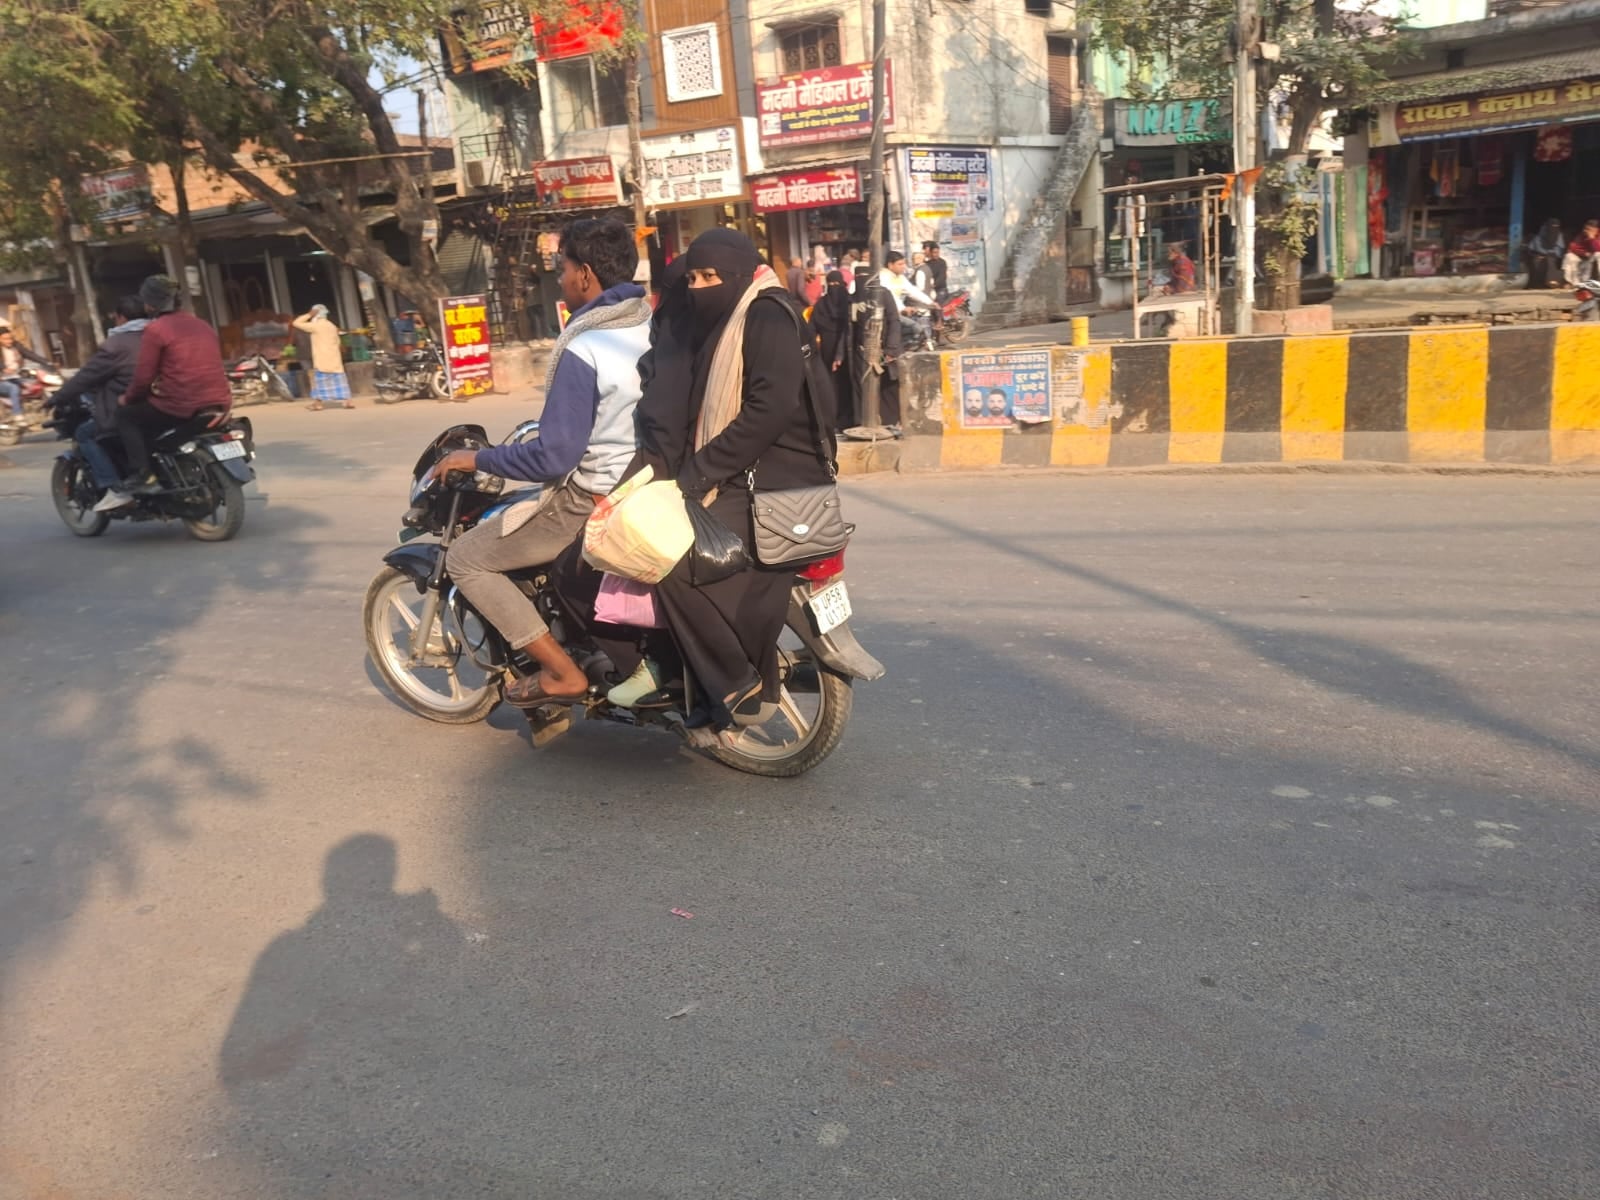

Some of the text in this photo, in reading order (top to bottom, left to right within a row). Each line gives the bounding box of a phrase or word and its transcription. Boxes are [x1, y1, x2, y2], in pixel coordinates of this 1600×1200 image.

[760, 80, 797, 111] मदनी
[797, 76, 848, 106] मेडिकल
[1402, 101, 1471, 123] रायल
[911, 153, 986, 173] मदनी मेडिकल स्टोर
[755, 174, 857, 208] मदनी मेडिकल स्टोर
